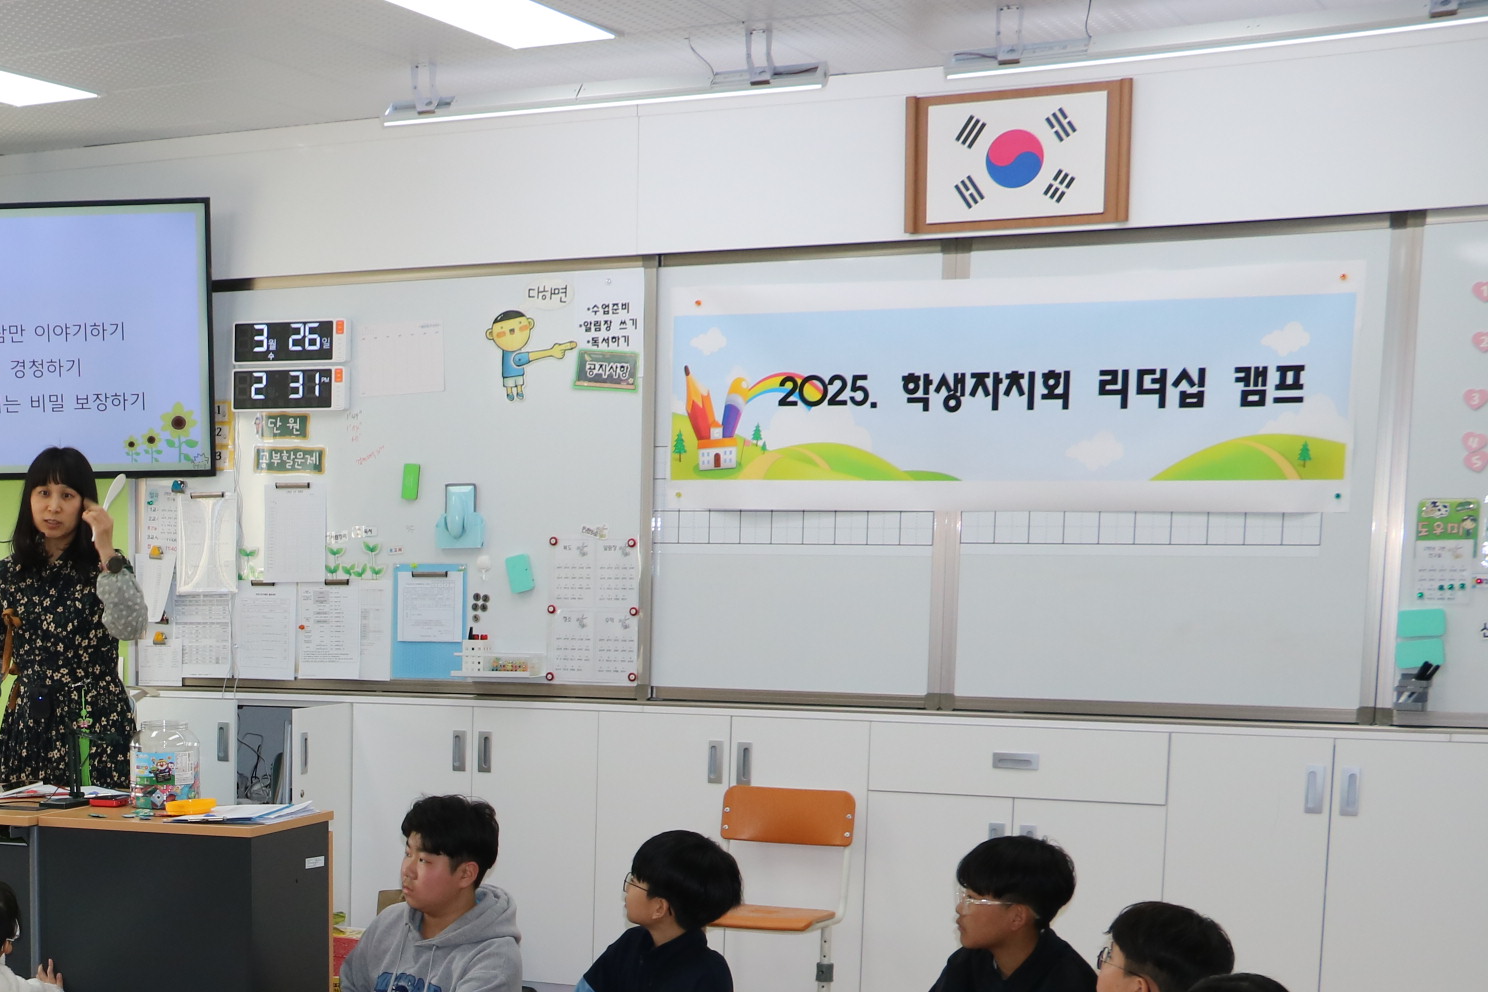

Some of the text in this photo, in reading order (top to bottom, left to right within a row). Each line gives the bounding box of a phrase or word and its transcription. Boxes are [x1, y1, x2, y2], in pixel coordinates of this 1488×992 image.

[528, 284, 568, 303] 다하면
[592, 302, 630, 315] 수업준비
[34, 321, 126, 343] 이야기하기
[583, 318, 638, 332] 알림장 쓰기
[592, 336, 630, 348] 독서하기
[10, 358, 82, 379] 경청하기
[586, 362, 630, 378] 공지사항
[251, 372, 267, 399] 2
[288, 371, 320, 398] 31
[777, 364, 1306, 413] 2025. 학생자치회 리더십 캠프
[30, 393, 64, 413] 비밀
[74, 391, 147, 412] 보장하기
[1472, 393, 1480, 404] 3
[1468, 436, 1478, 448] 4
[259, 451, 320, 469] 공부할문제
[1472, 455, 1482, 468] 5
[1417, 521, 1463, 537] 도우미
